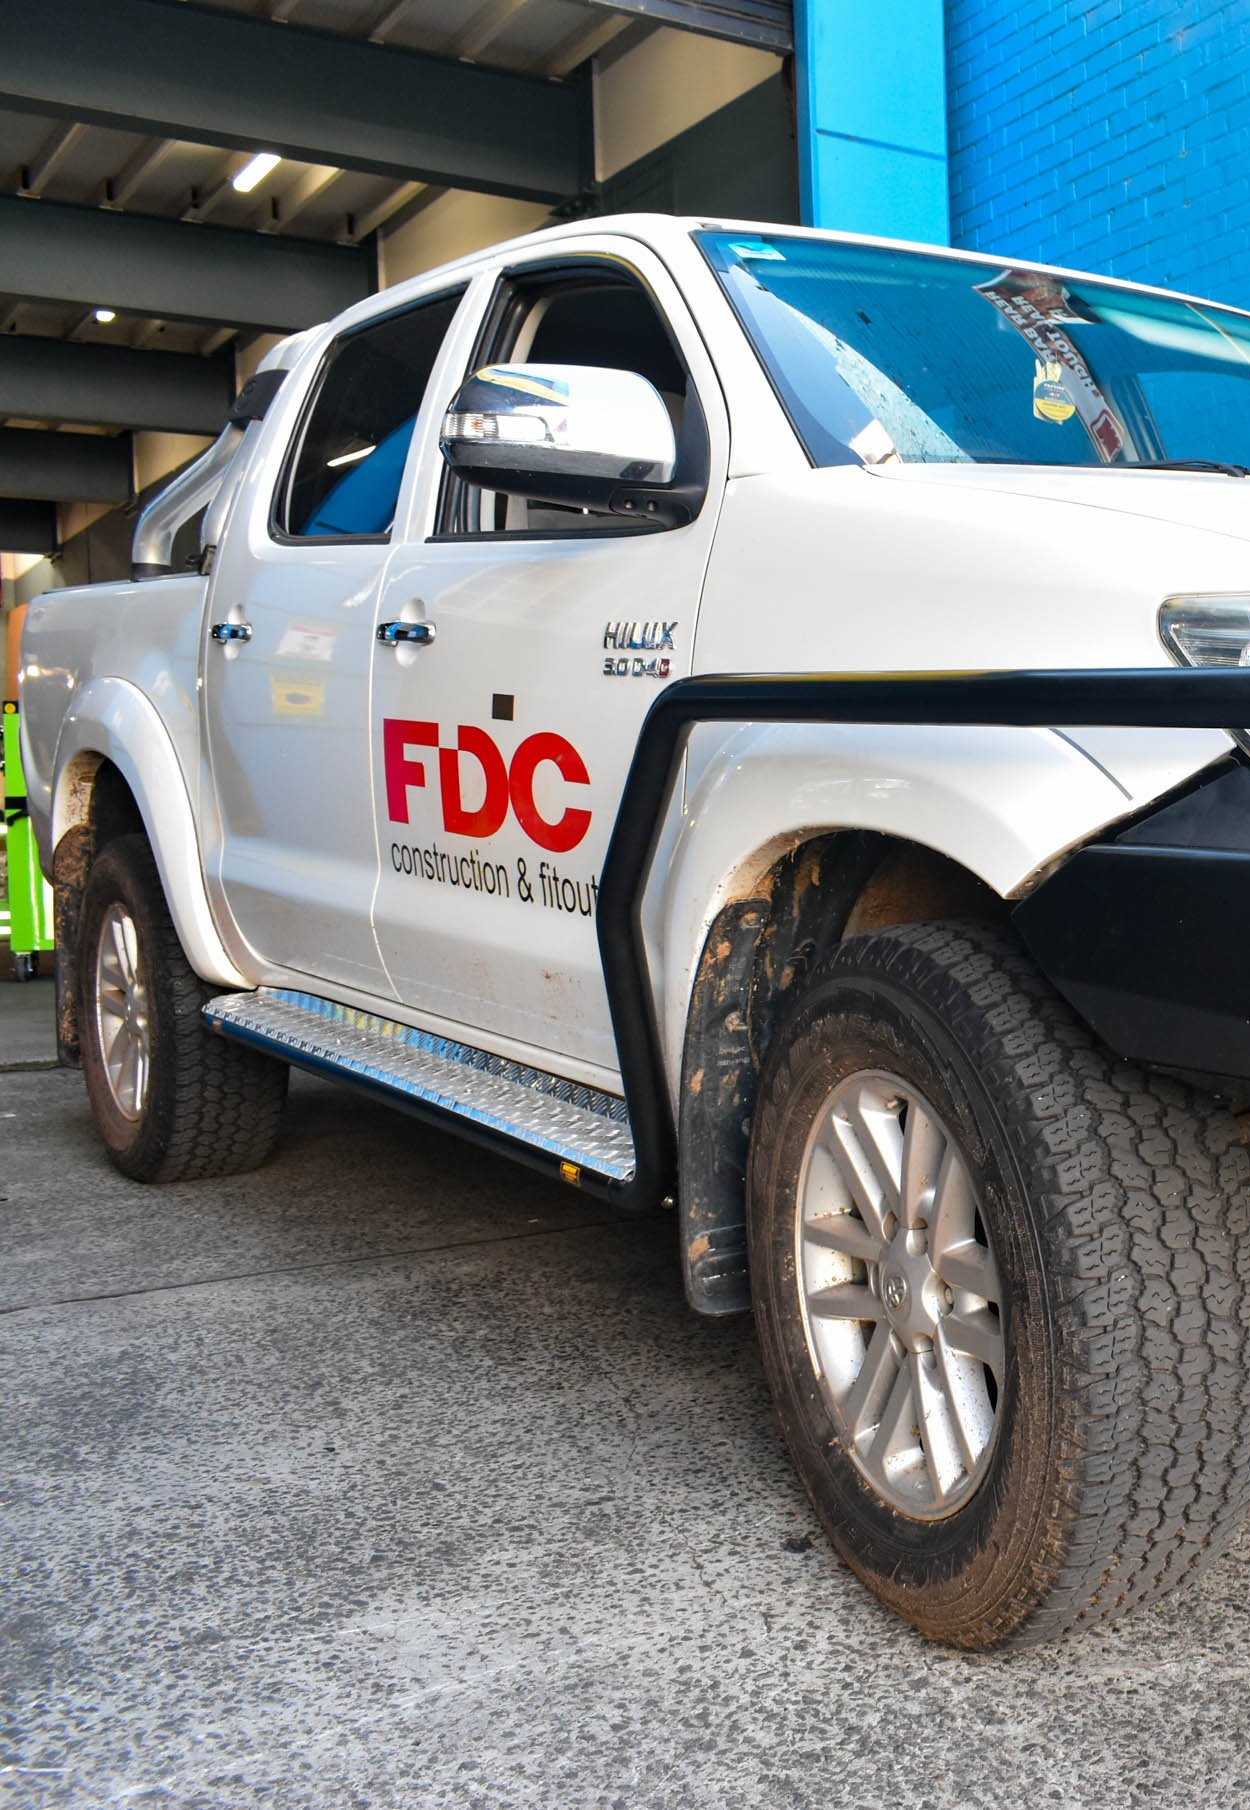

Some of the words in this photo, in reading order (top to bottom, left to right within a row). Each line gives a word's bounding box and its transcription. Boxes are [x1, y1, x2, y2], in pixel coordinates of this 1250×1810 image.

[603, 621, 679, 650] HILUX
[383, 717, 593, 853] FDC
[391, 841, 510, 898] construction
[517, 856, 534, 904] &
[538, 861, 599, 918] fitout
